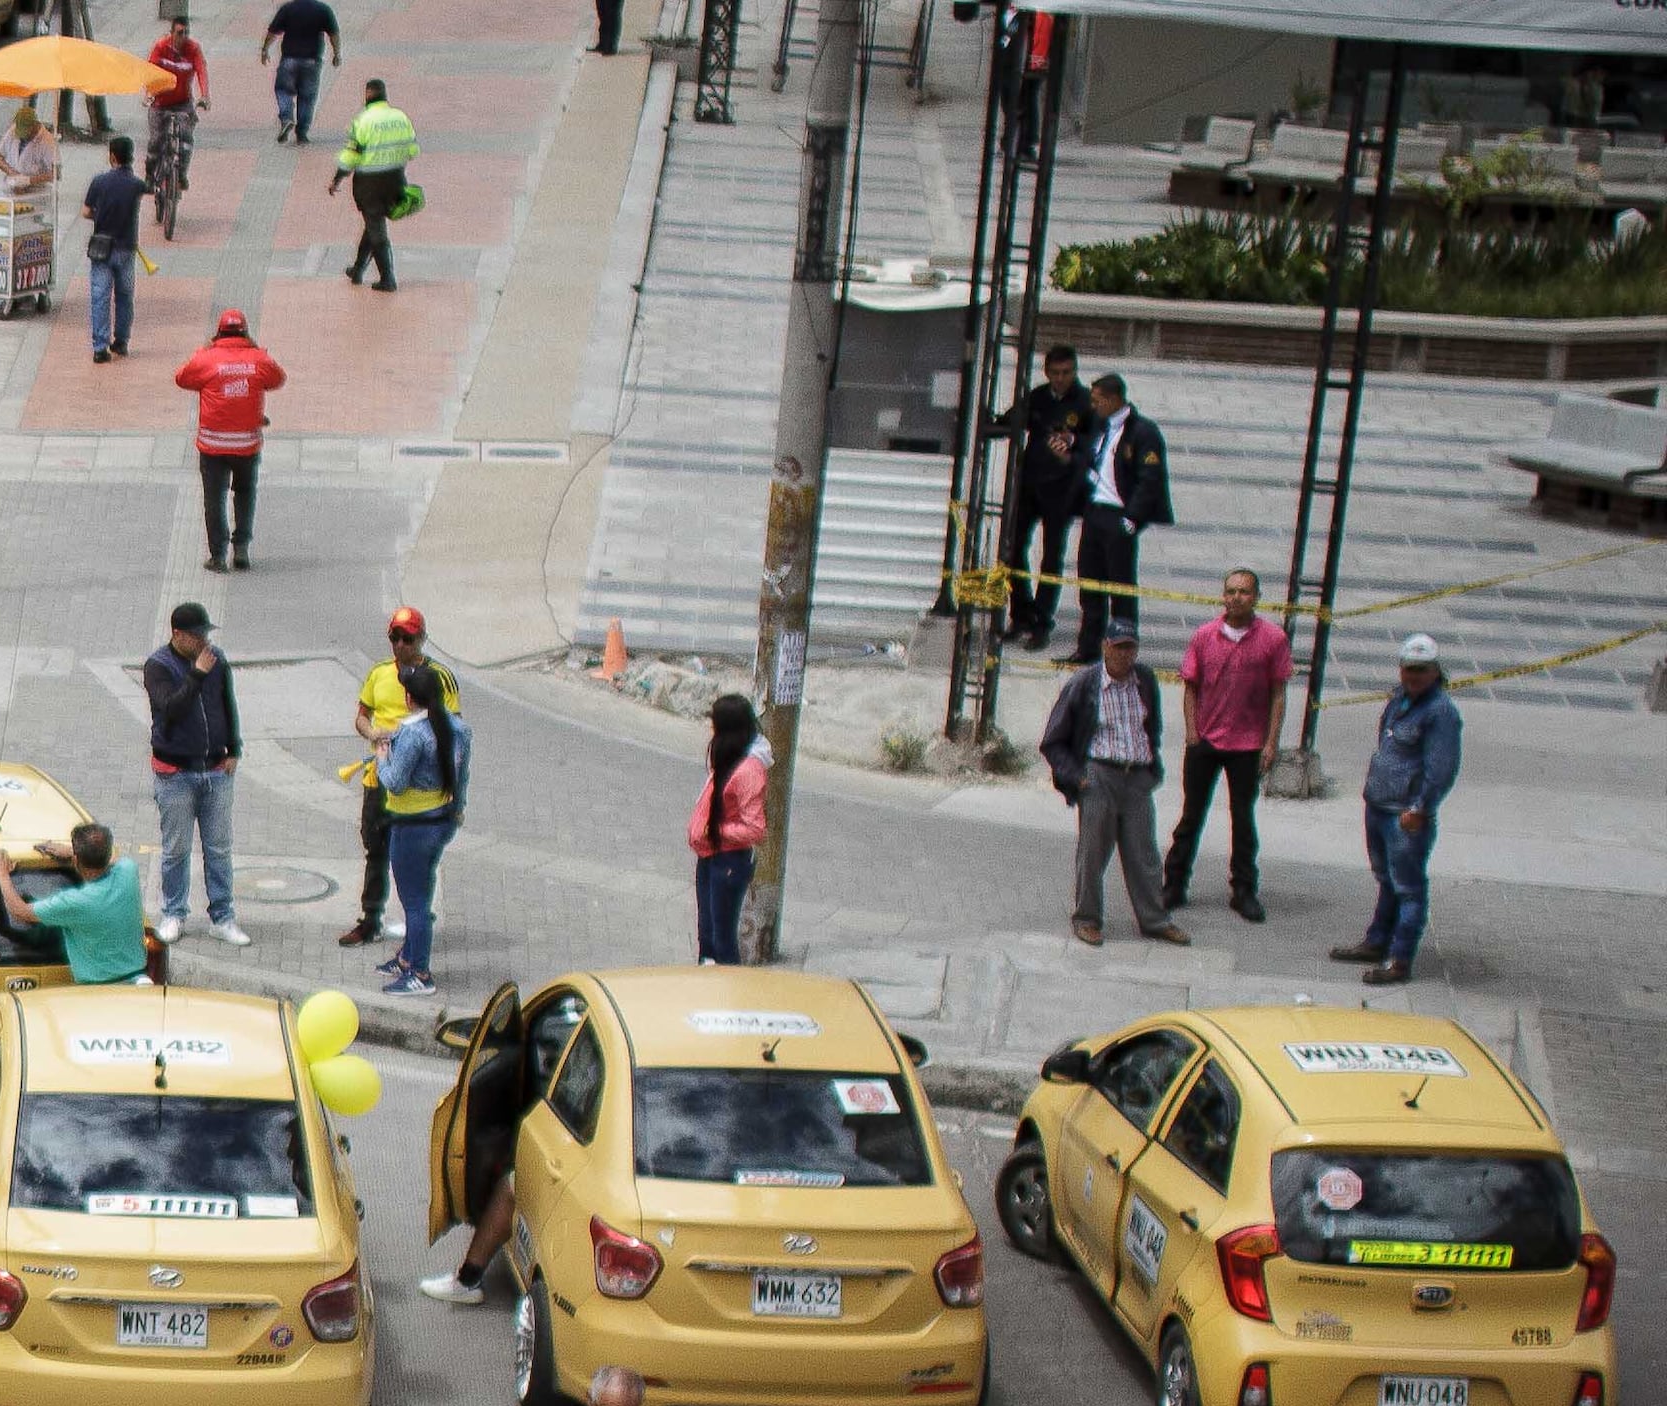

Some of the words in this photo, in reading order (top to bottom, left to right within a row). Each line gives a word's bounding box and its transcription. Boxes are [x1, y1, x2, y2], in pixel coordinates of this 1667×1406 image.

[758, 1280, 795, 1303] WMM
[801, 1282, 839, 1305] 632
[122, 1312, 158, 1335] WNT
[167, 1313, 205, 1336] 482
